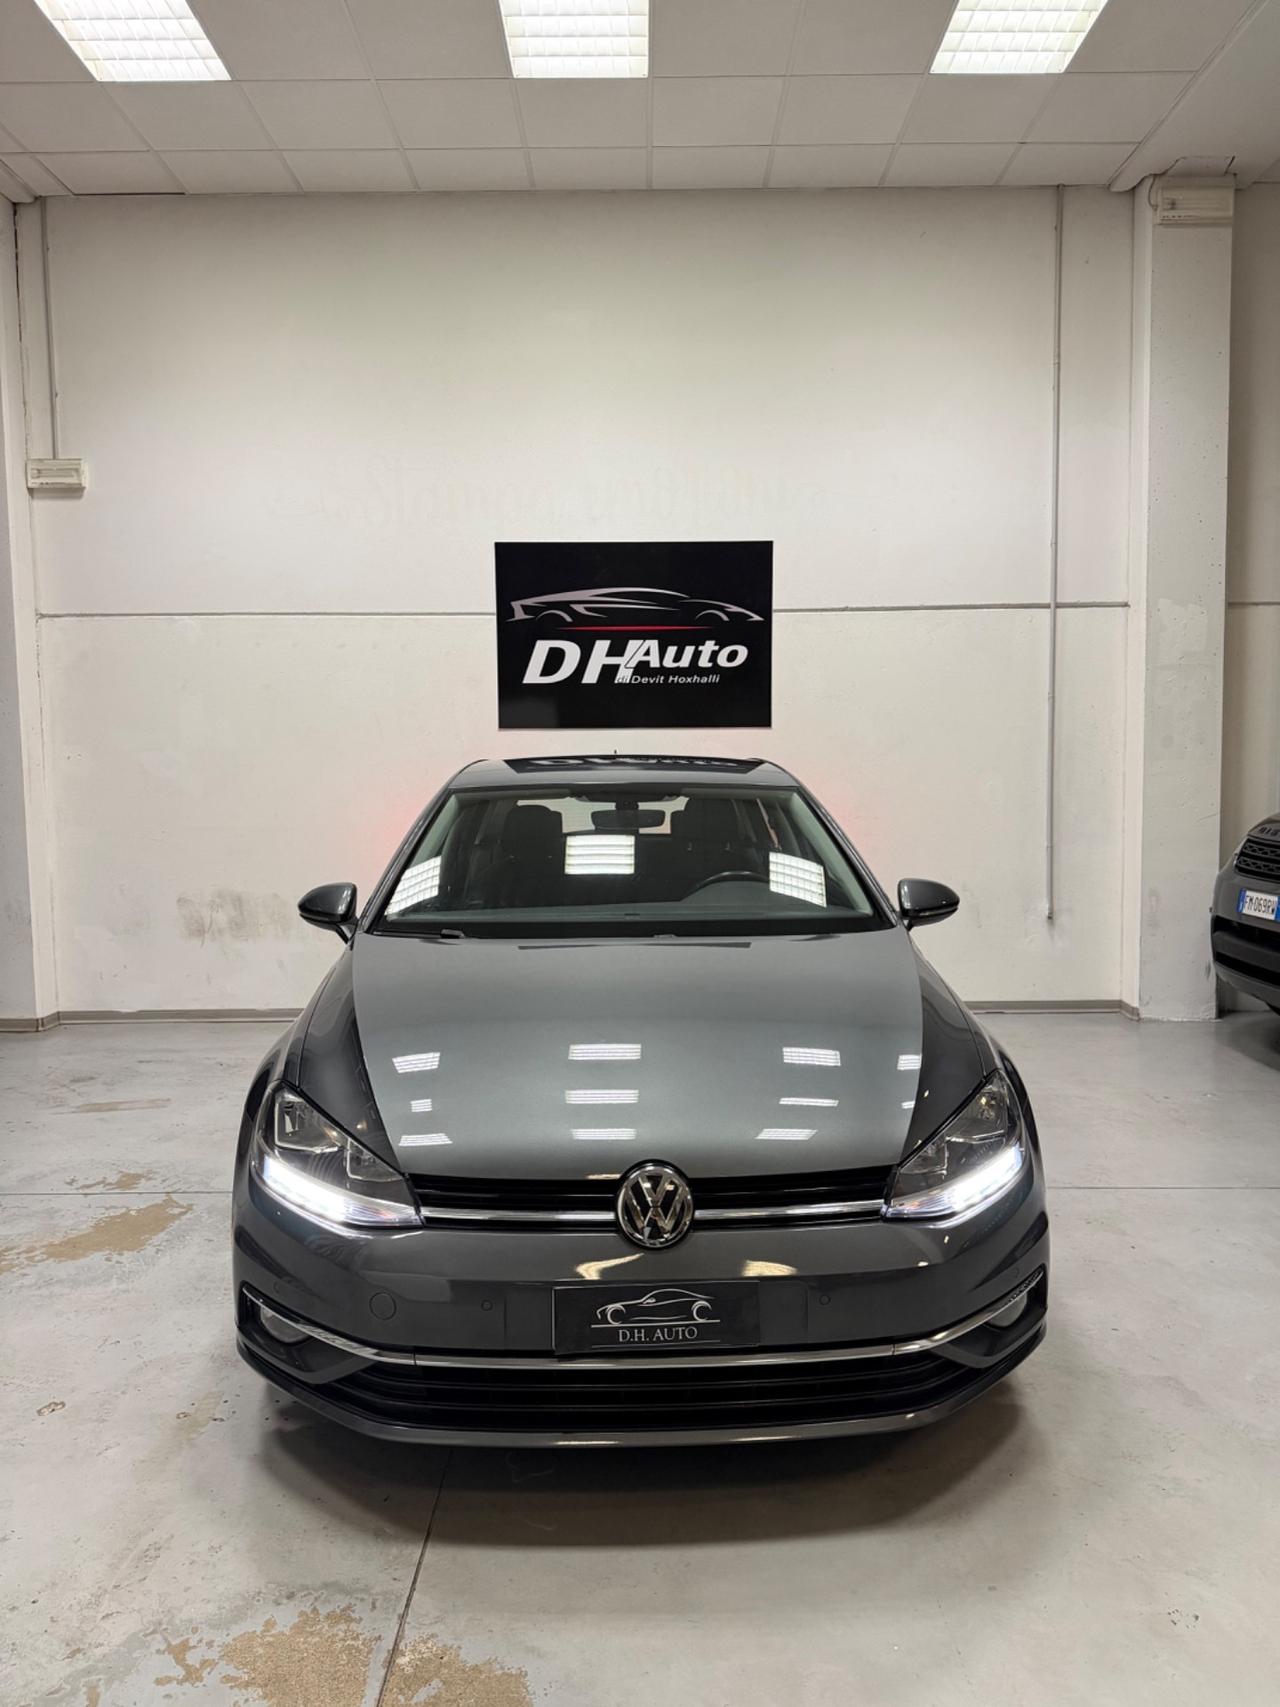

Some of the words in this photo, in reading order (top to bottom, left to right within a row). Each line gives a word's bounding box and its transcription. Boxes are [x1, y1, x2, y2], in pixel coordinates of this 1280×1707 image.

[631, 675, 665, 684] Devit
[667, 674, 721, 684] Hoxhalli
[618, 1328, 650, 1342] D.H.
[653, 1326, 698, 1341] AUTO
